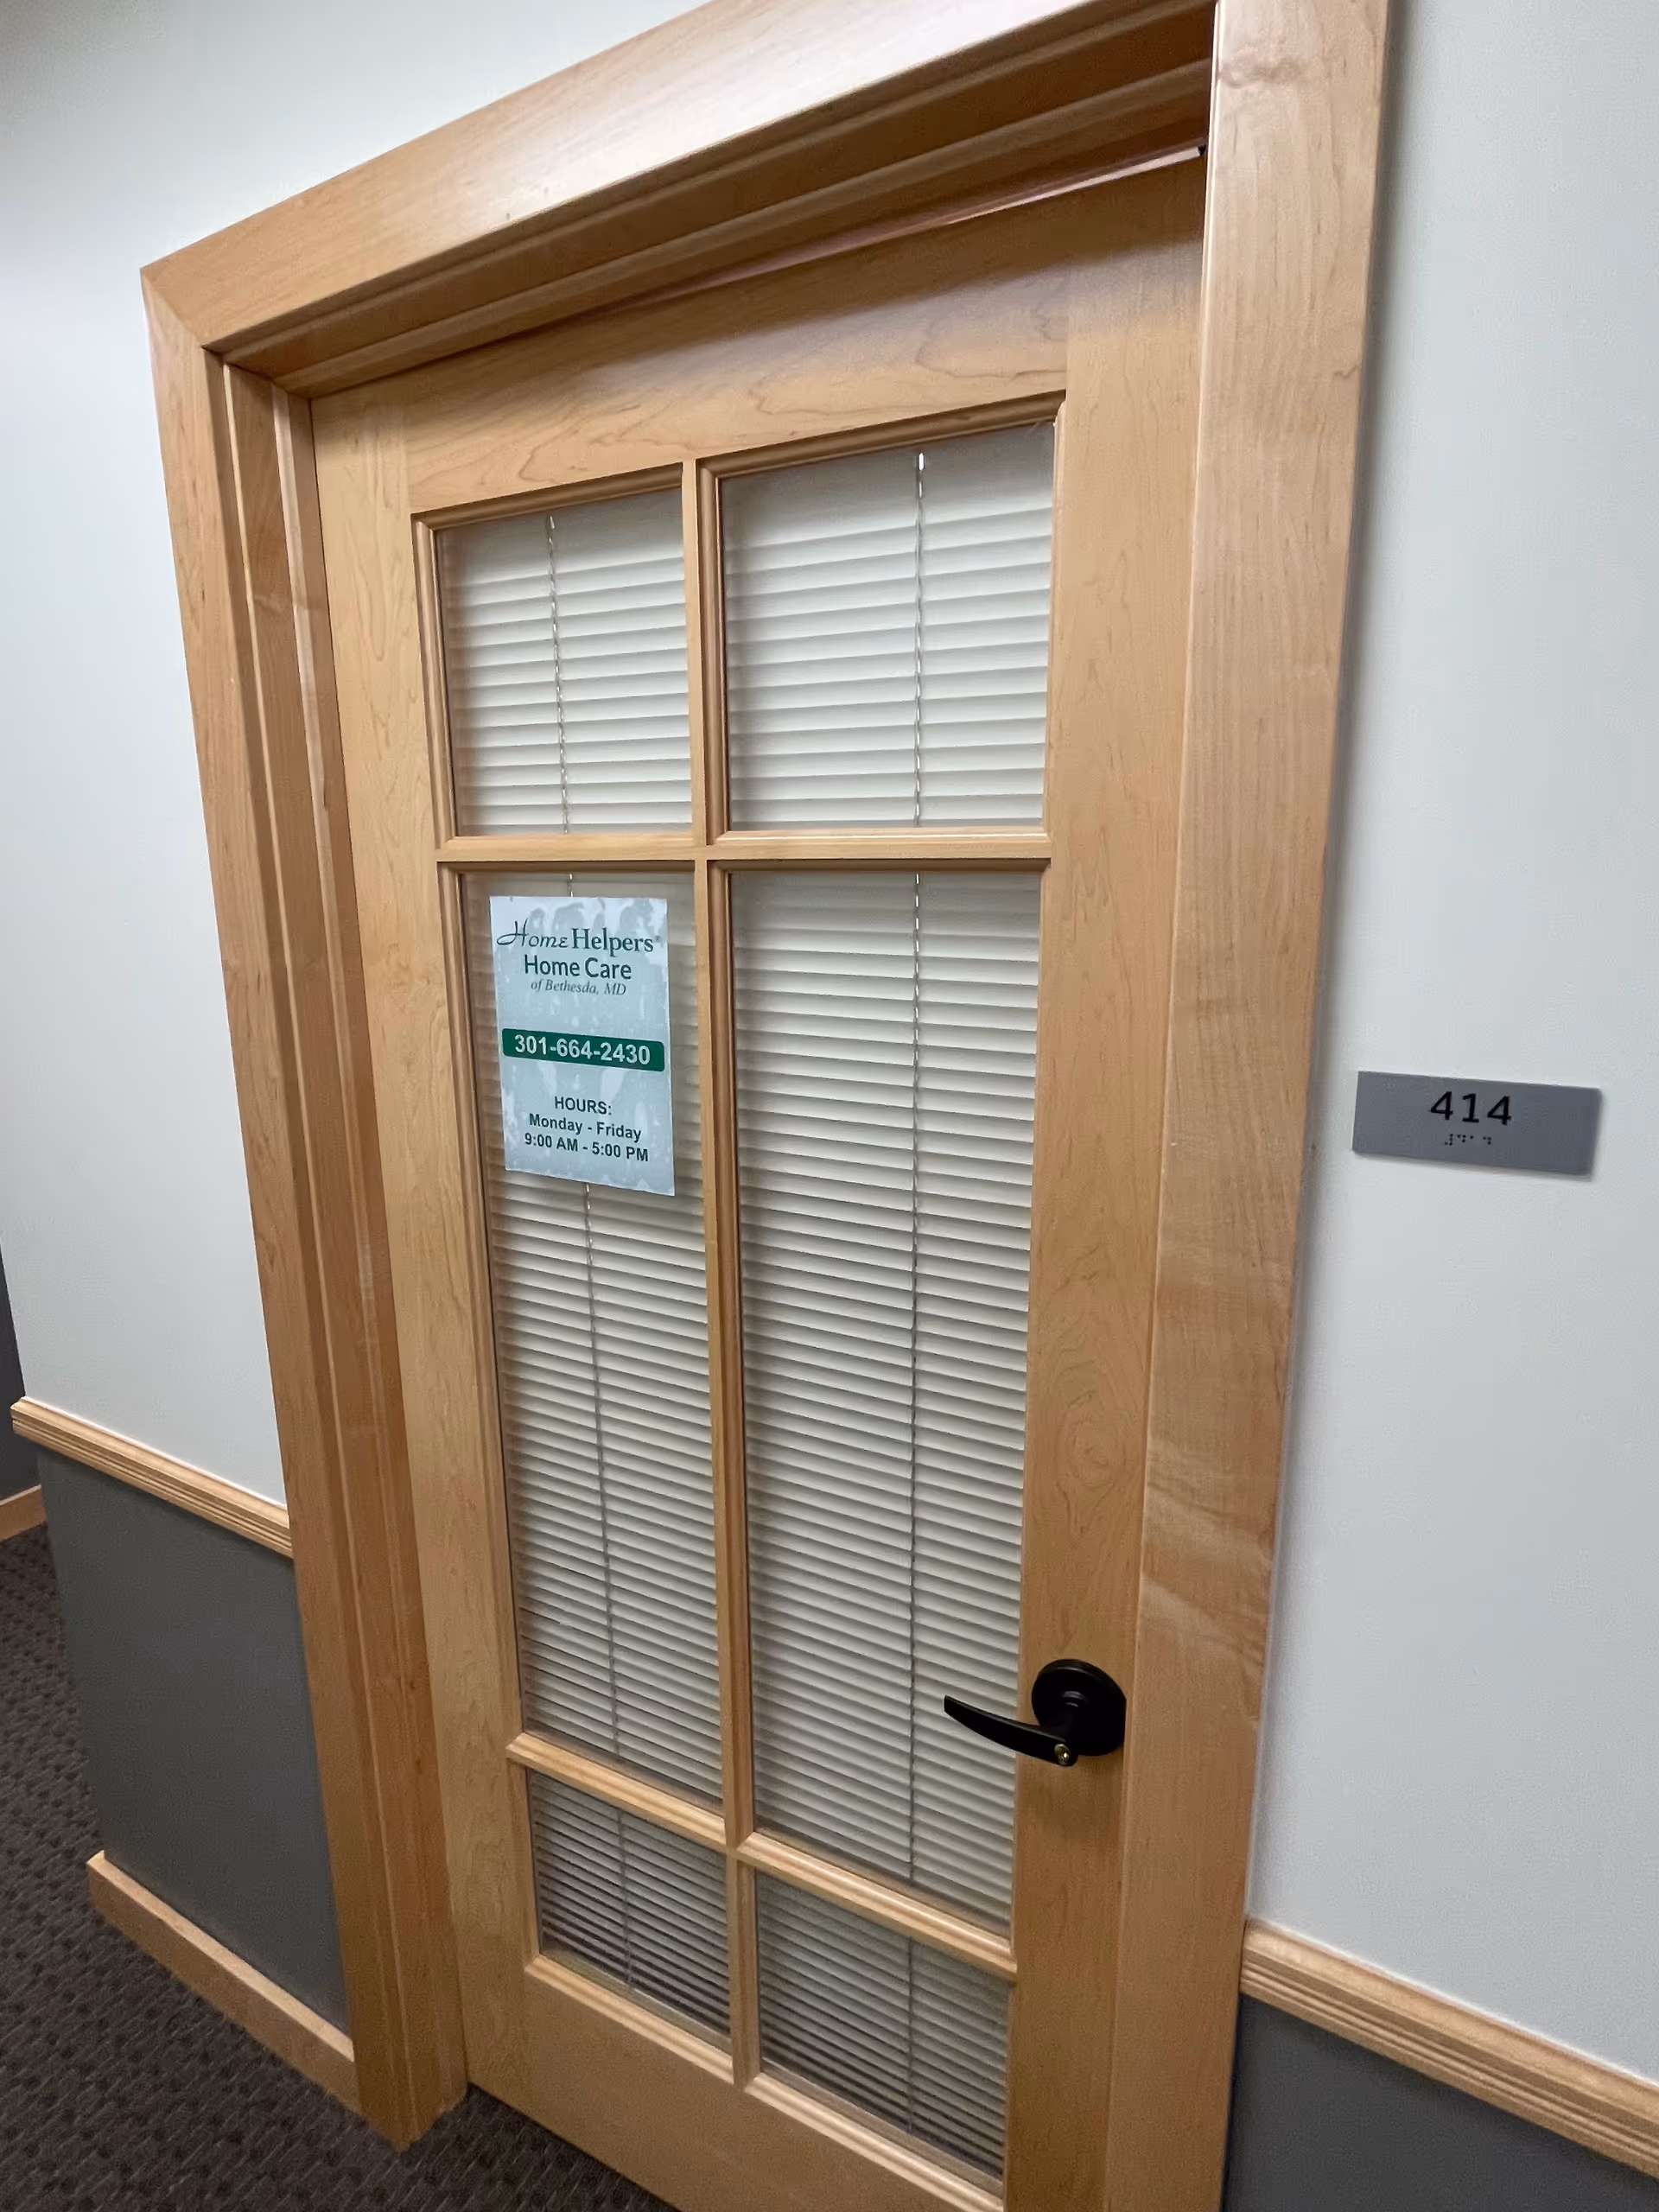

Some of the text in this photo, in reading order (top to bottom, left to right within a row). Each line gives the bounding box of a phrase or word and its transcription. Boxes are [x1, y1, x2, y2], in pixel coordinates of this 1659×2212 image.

[497, 918, 569, 948] Home
[524, 954, 632, 979] Home Care
[531, 979, 626, 995] of Bethesda, MD
[514, 1034, 651, 1065] 301-664-2430
[554, 1096, 612, 1116] HOURS:
[1429, 1090, 1512, 1125] 414
[529, 1113, 583, 1135] Monday
[596, 1122, 642, 1142] Friday
[524, 1133, 552, 1148] 9:00
[556, 1137, 578, 1152] AM
[592, 1141, 621, 1158] 5:00
[626, 1147, 648, 1161] PM
